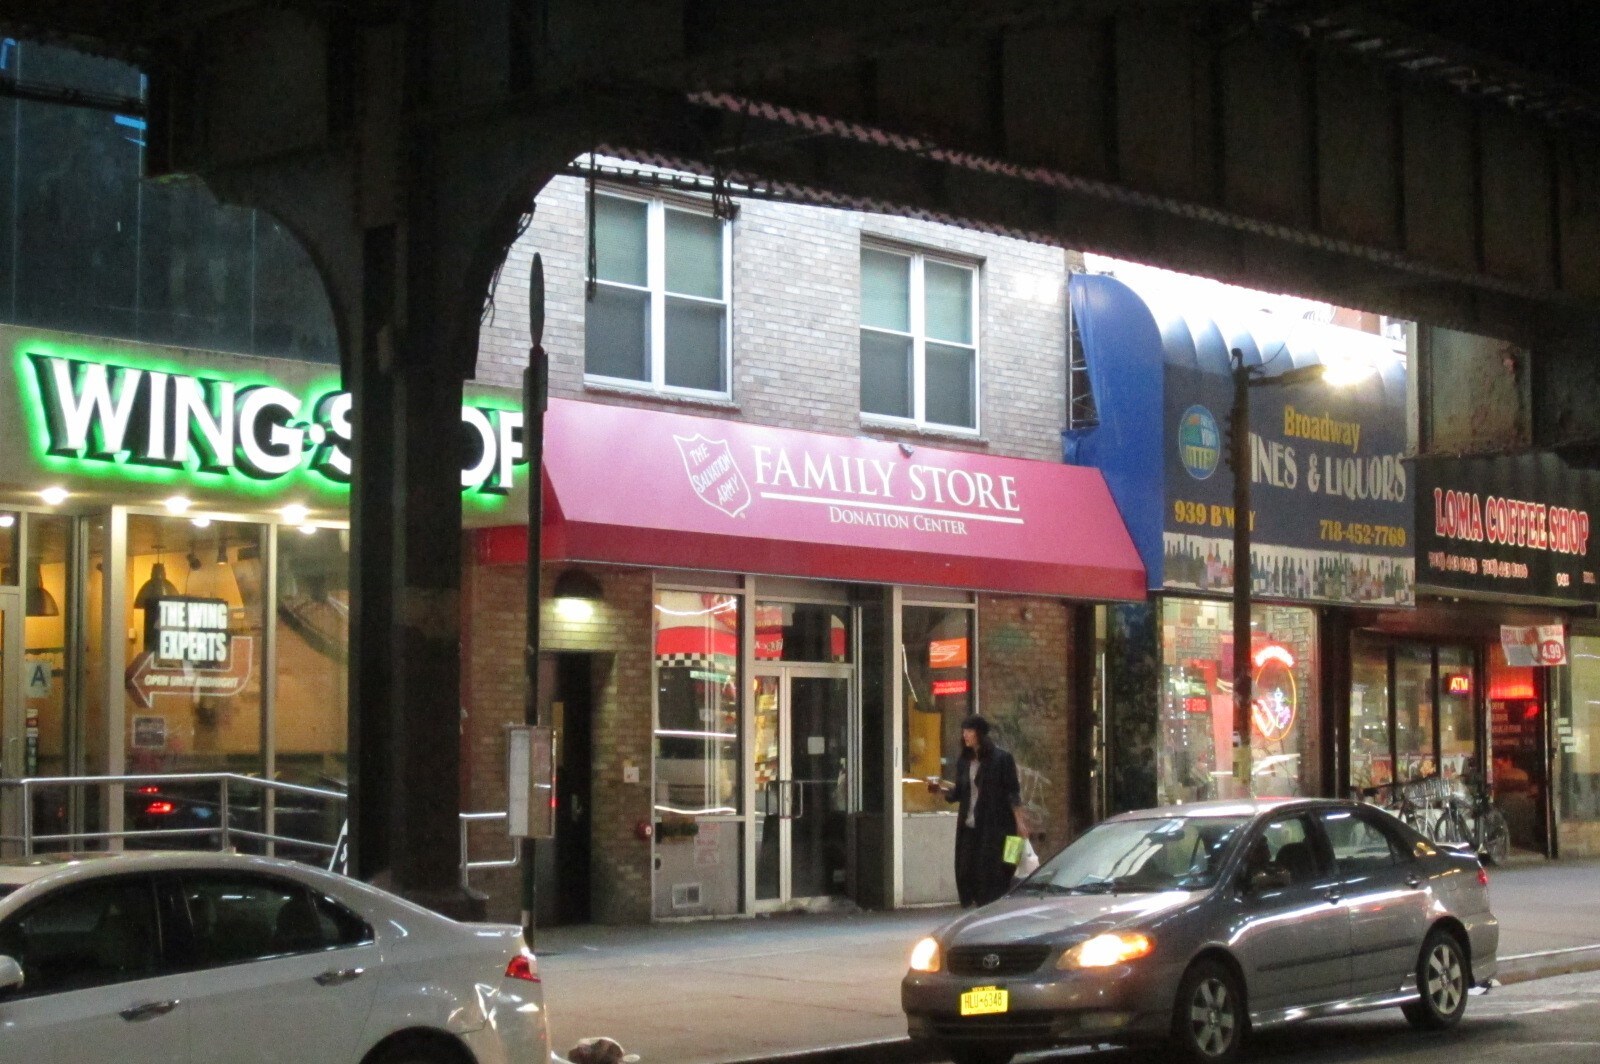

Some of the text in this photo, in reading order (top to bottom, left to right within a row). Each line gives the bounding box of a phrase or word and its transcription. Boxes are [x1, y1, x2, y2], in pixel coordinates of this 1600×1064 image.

[1284, 404, 1360, 454] Broadway
[689, 443, 710, 466] THE
[1248, 431, 1406, 503] INES & LIQUORS
[716, 473, 739, 506] ARMY
[752, 446, 1020, 512] FAMILY STORE
[829, 506, 968, 536] DONATION CENTER
[1174, 500, 1256, 532] 939 B'WY
[1434, 487, 1589, 556] LOMA COFFEE SHOP
[159, 600, 228, 630] THE WING
[160, 630, 227, 662] EXPERTS
[30, 665, 46, 687] A
[1450, 677, 1469, 691] ATM
